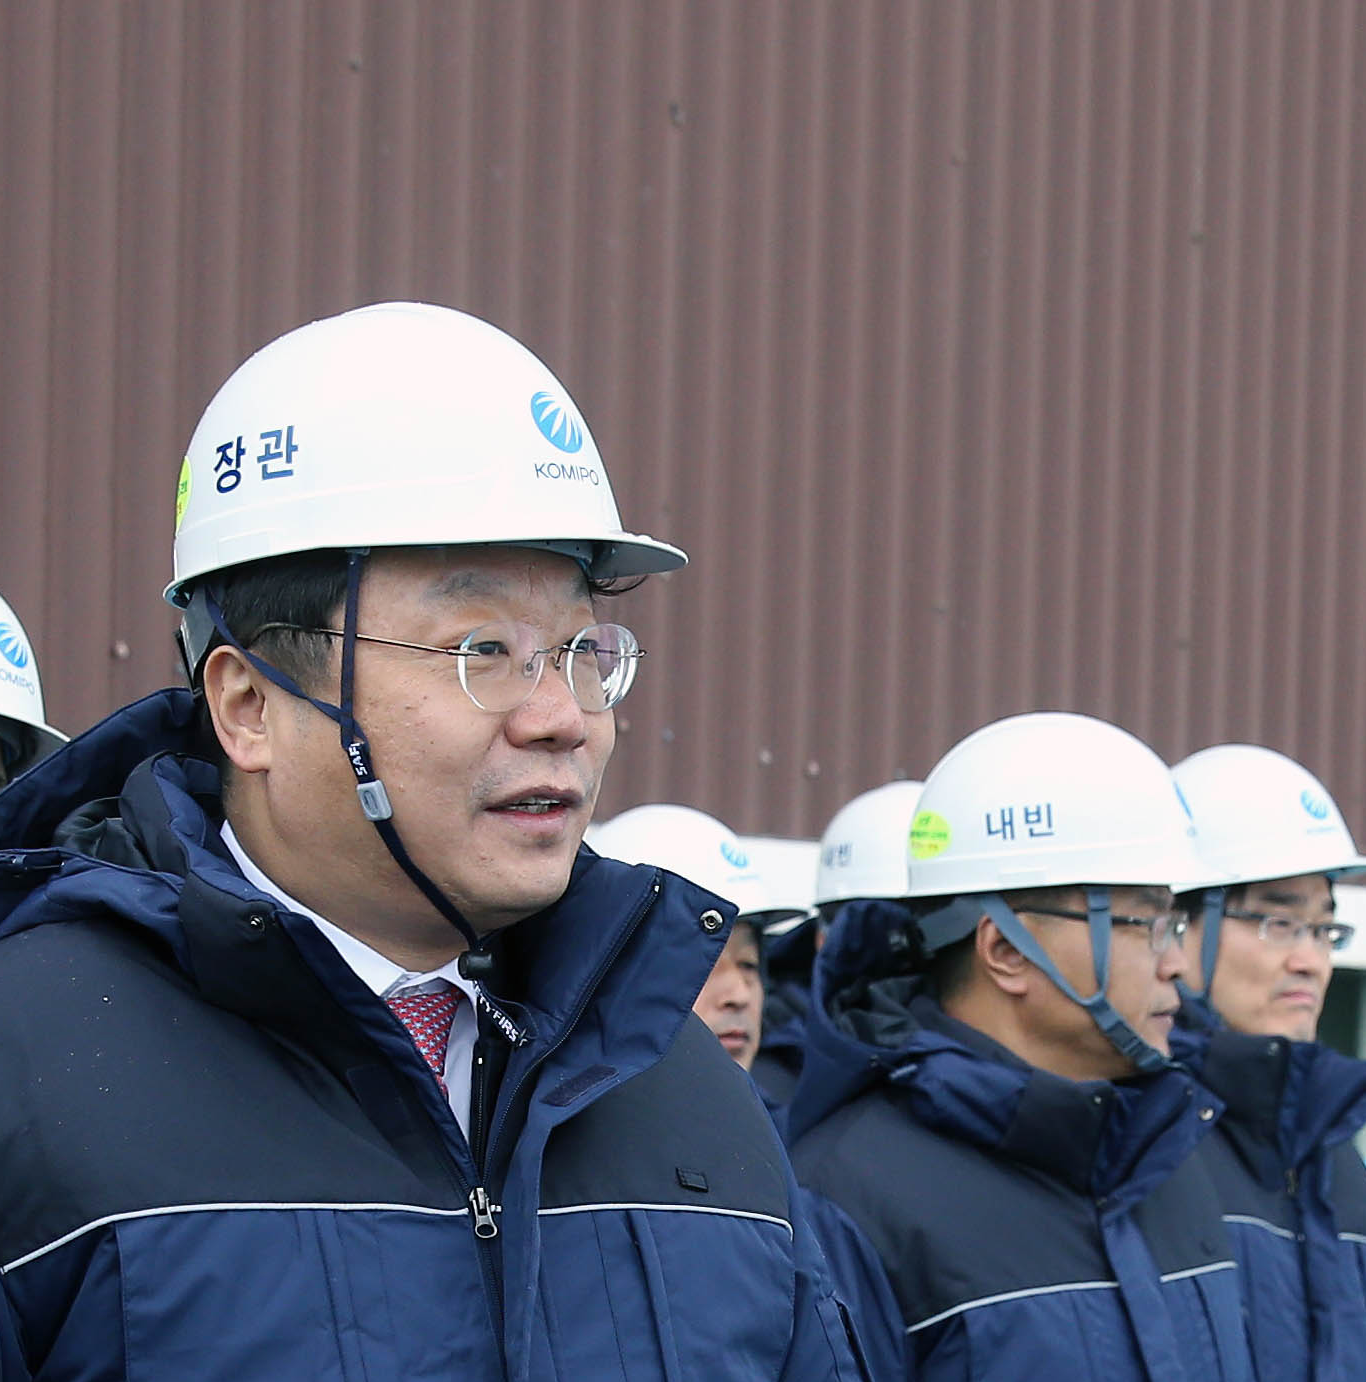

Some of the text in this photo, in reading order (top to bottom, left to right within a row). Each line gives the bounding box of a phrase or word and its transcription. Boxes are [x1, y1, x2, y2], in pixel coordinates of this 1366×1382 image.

[213, 425, 298, 494] 장관
[534, 463, 599, 485] KOMIPO
[986, 803, 1055, 840] 내빈
